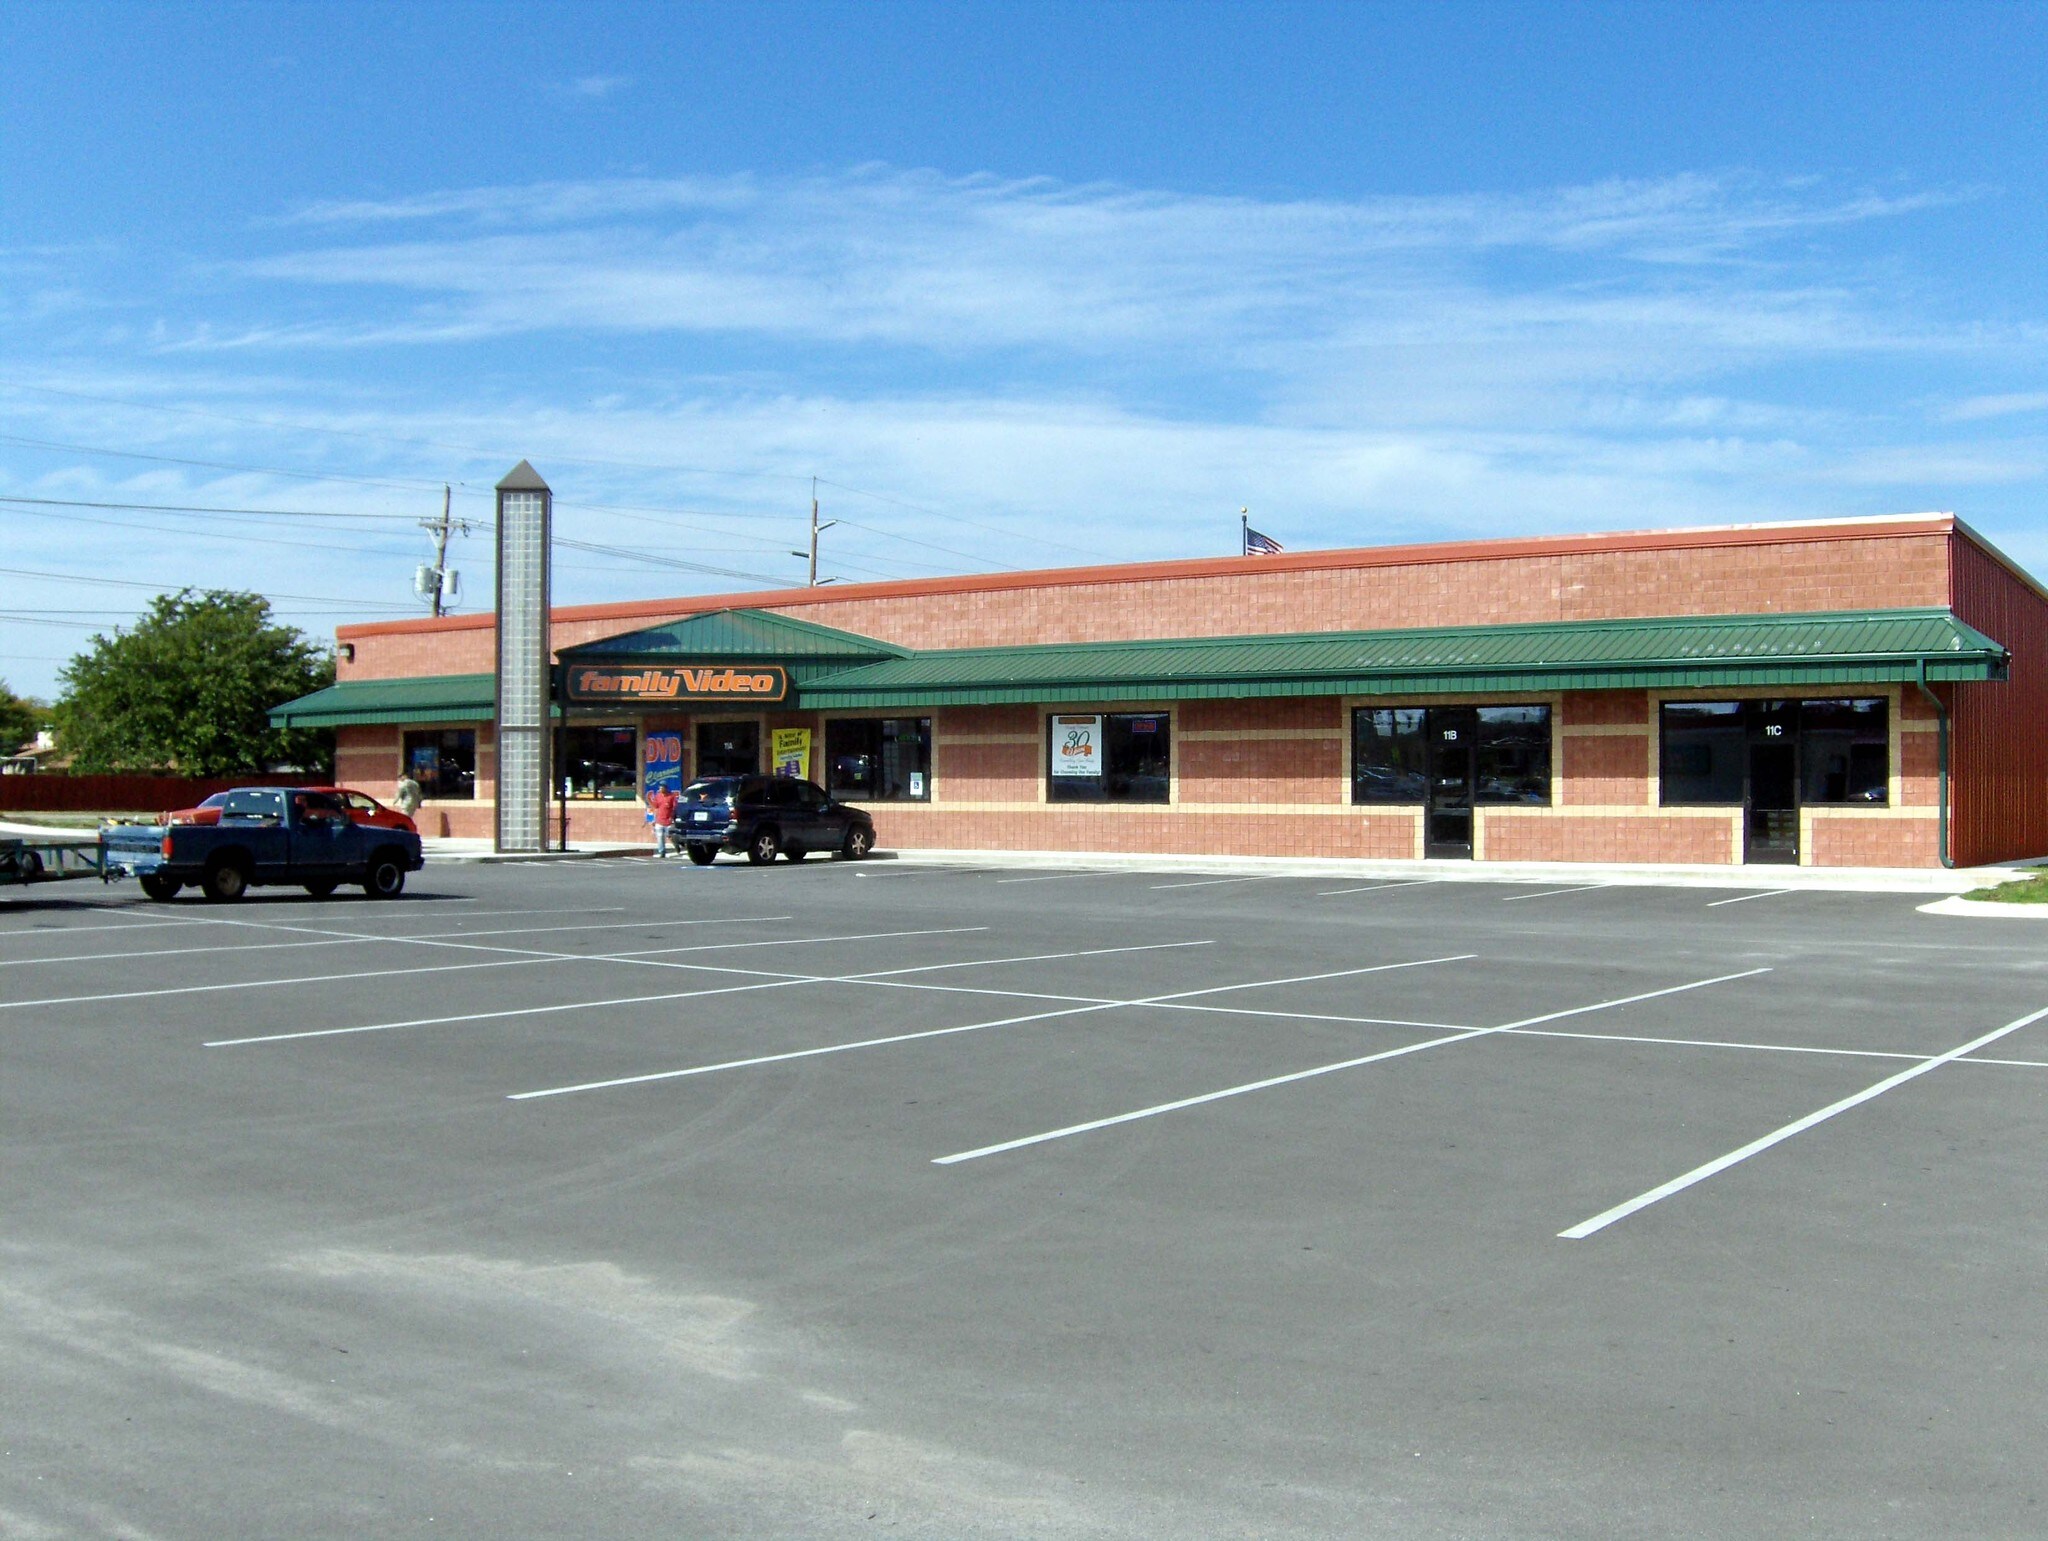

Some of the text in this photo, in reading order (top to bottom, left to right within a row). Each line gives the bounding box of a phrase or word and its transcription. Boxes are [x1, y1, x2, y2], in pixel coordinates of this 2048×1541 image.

[580, 670, 774, 696] family Video
[1064, 730, 1090, 749] 30
[1443, 730, 1457, 740] 11B
[1765, 725, 1782, 735] 11C
[646, 737, 682, 762] DVD
